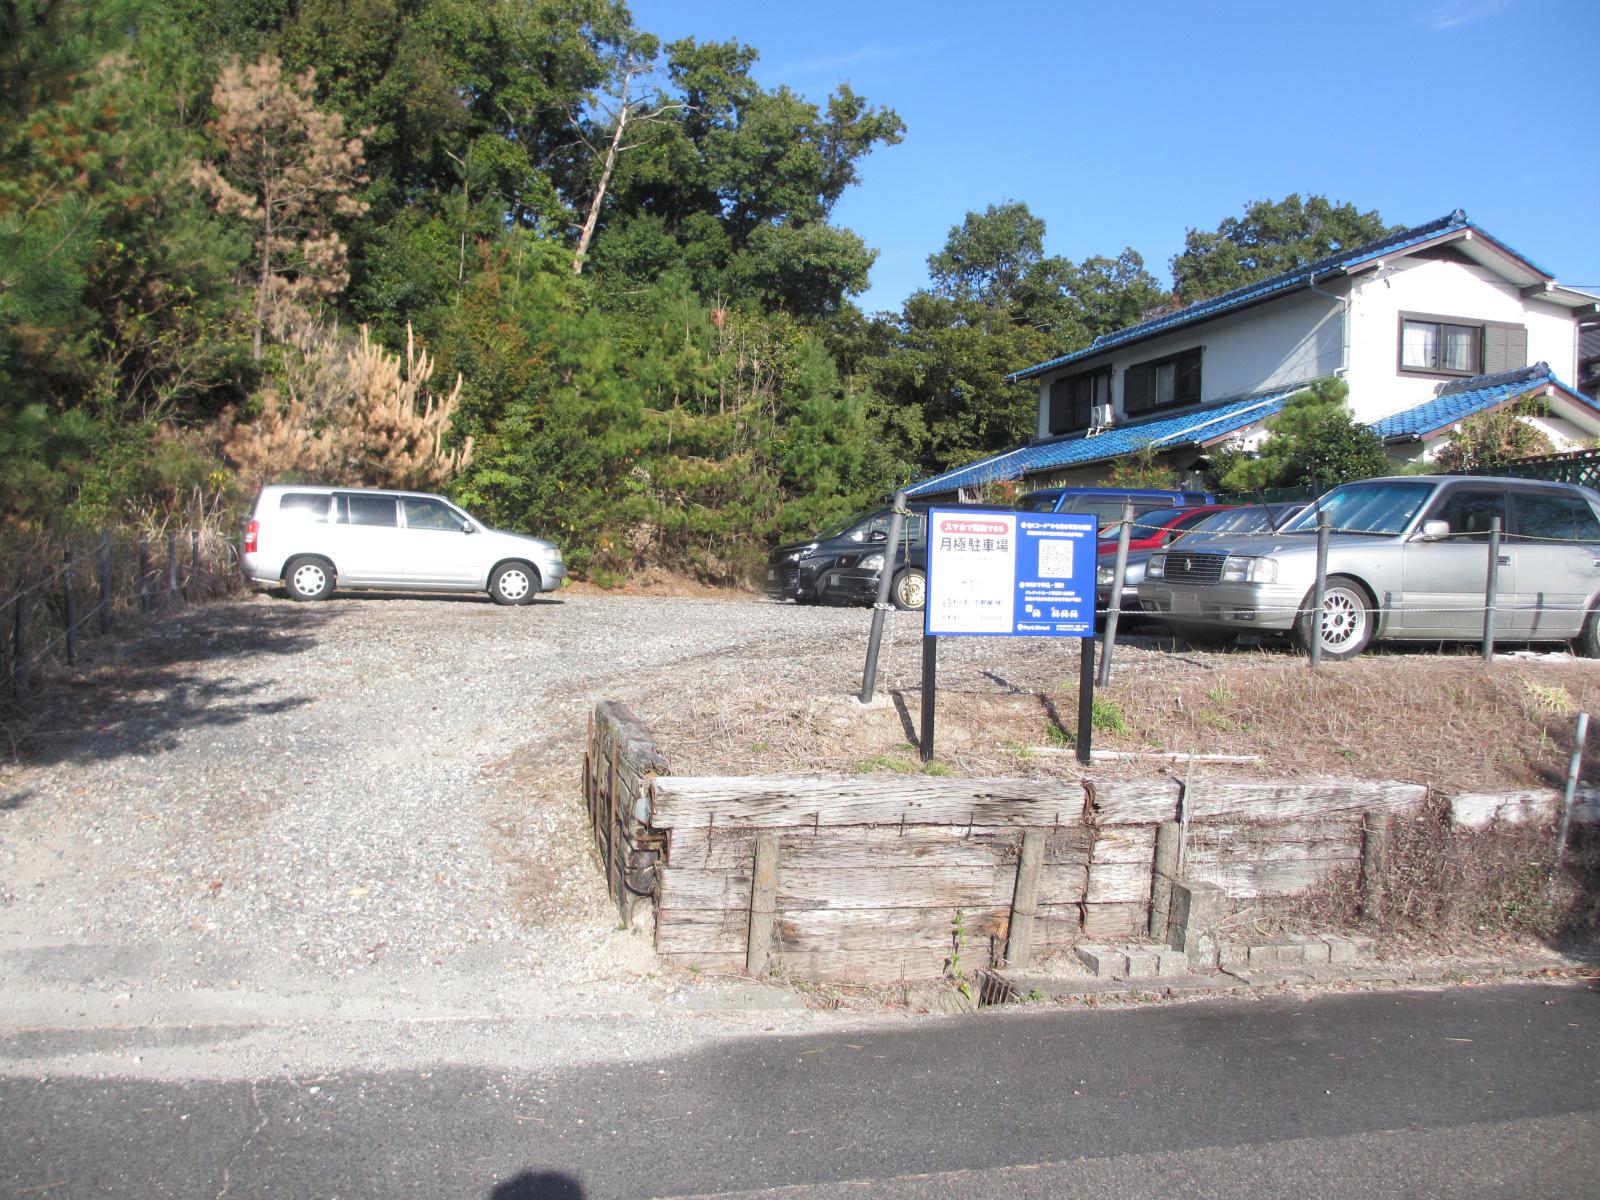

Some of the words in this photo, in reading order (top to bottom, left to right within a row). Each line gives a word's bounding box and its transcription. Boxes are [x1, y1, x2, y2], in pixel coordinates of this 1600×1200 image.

[940, 537, 1009, 553] 月極駐車場
